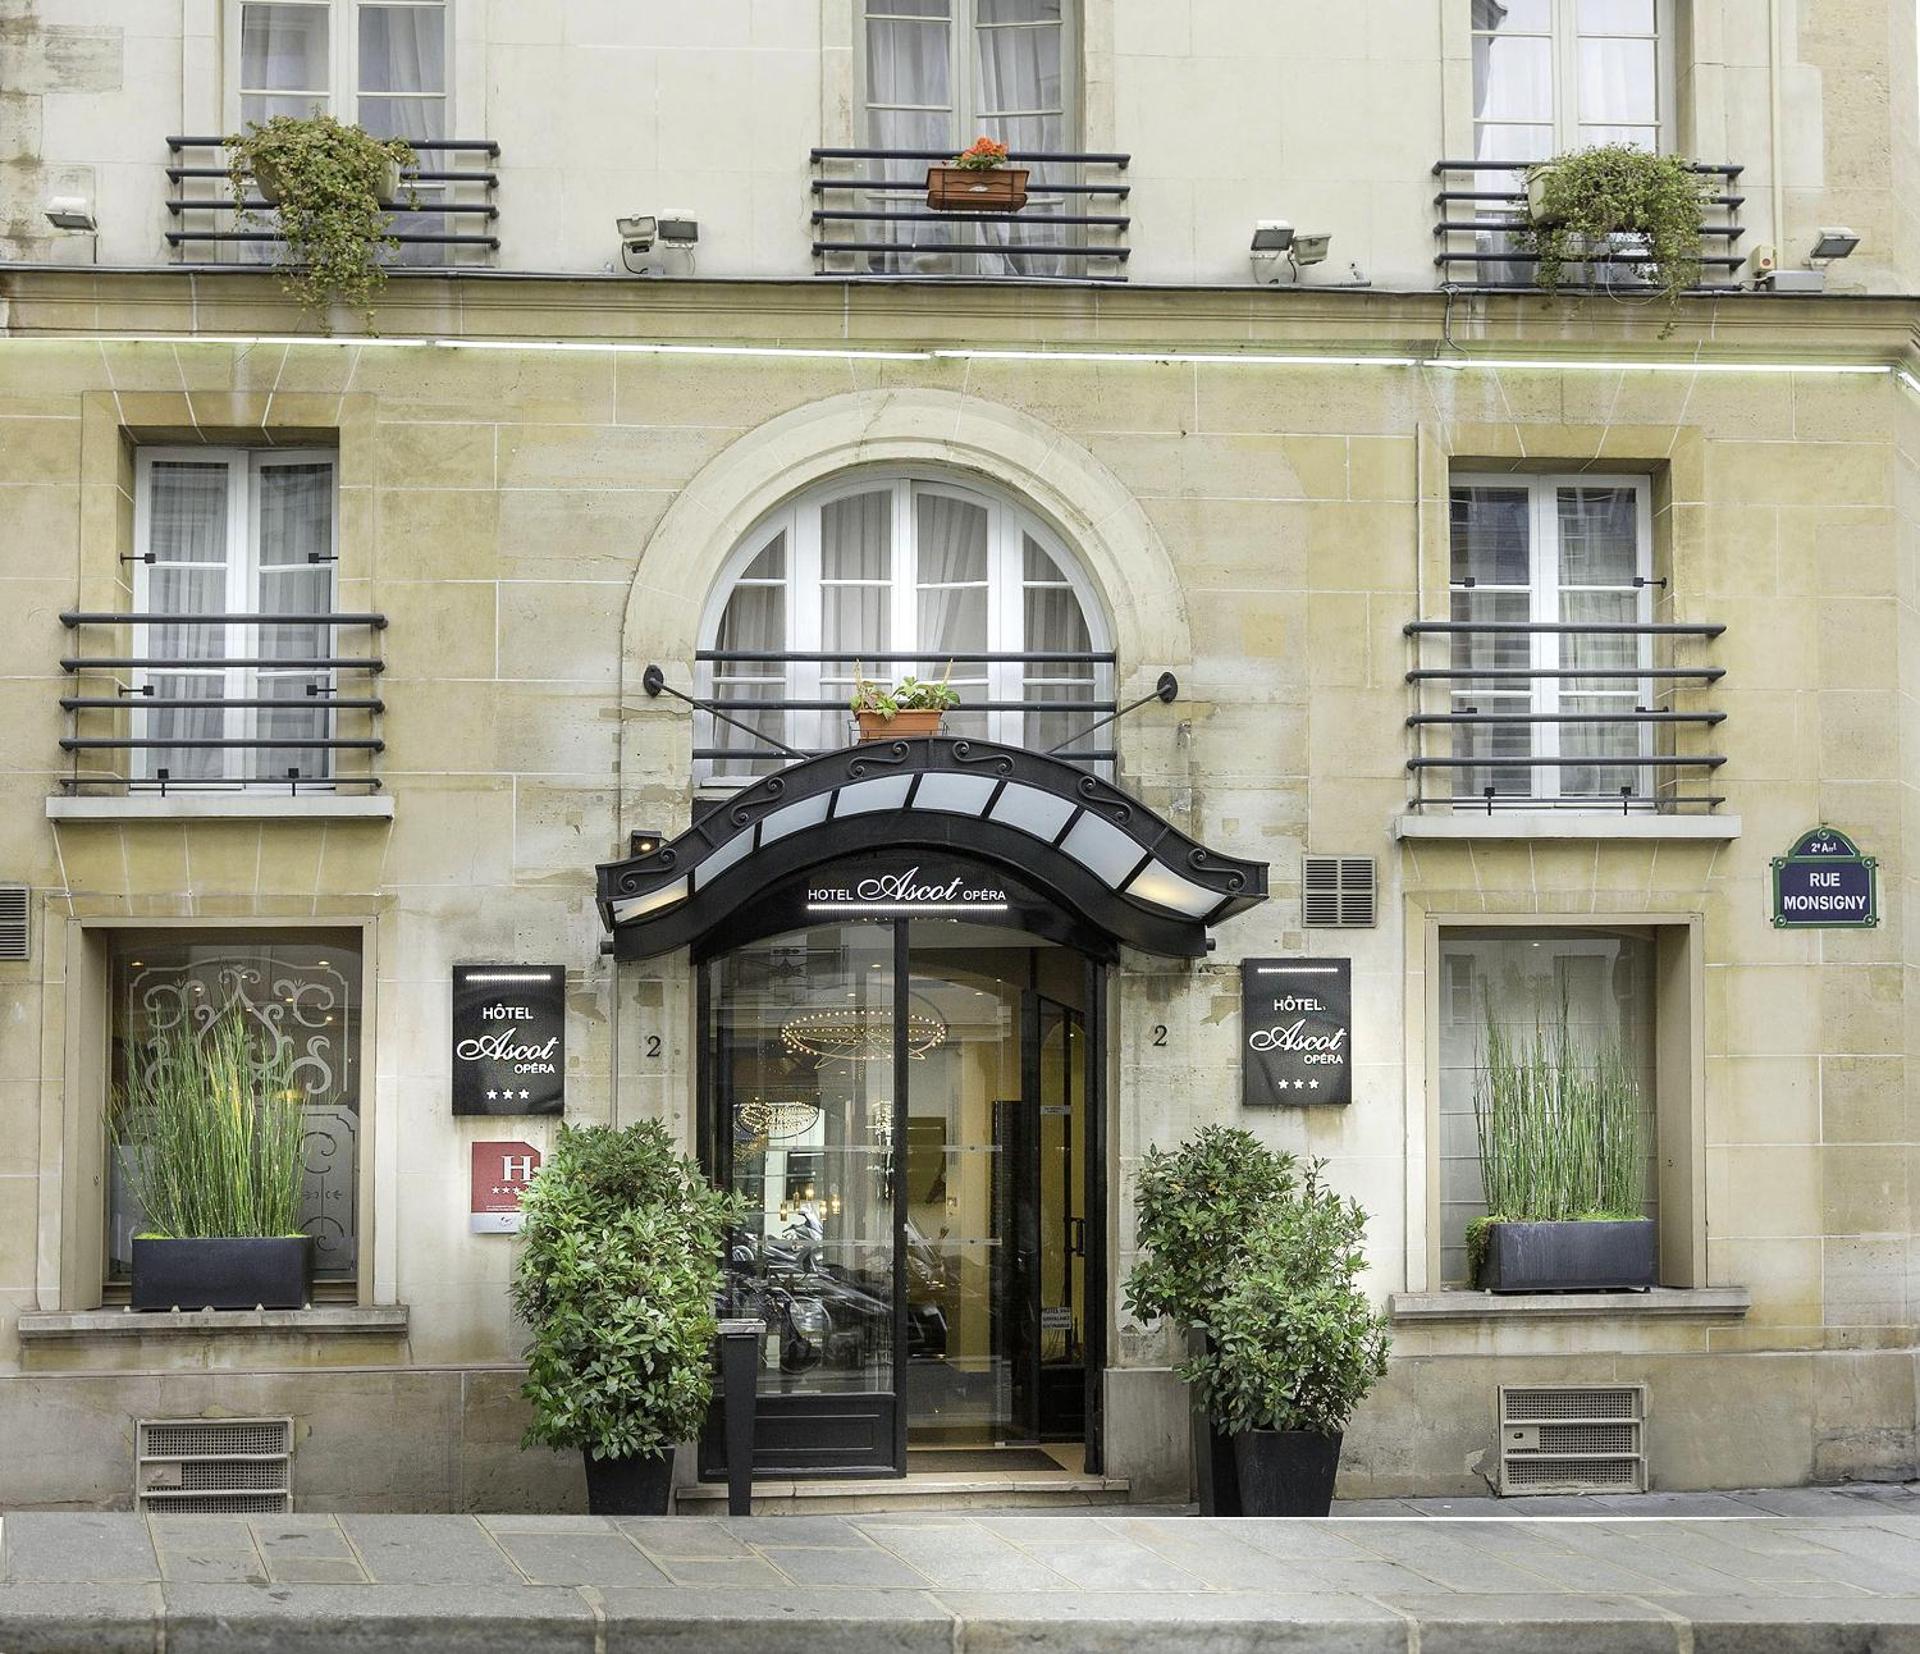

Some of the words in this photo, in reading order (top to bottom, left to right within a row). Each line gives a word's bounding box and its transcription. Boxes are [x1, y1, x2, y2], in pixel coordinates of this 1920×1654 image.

[807, 889, 853, 900] HOTEL
[857, 866, 963, 901] Ascot
[963, 887, 1006, 900] OPÉRA
[1809, 872, 1841, 887] RUE
[1783, 895, 1866, 910] MONSIGNY
[482, 1003, 534, 1020] HÔTEL
[1273, 995, 1322, 1011] HÔTEL
[456, 1027, 560, 1061] Ascot
[1152, 1024, 1167, 1047] 2
[1249, 1018, 1348, 1051] Ascot
[646, 1035, 661, 1057] 2
[514, 1062, 555, 1075] OPÉRA
[1303, 1053, 1344, 1065] OPÉRA
[501, 1155, 534, 1182] H
